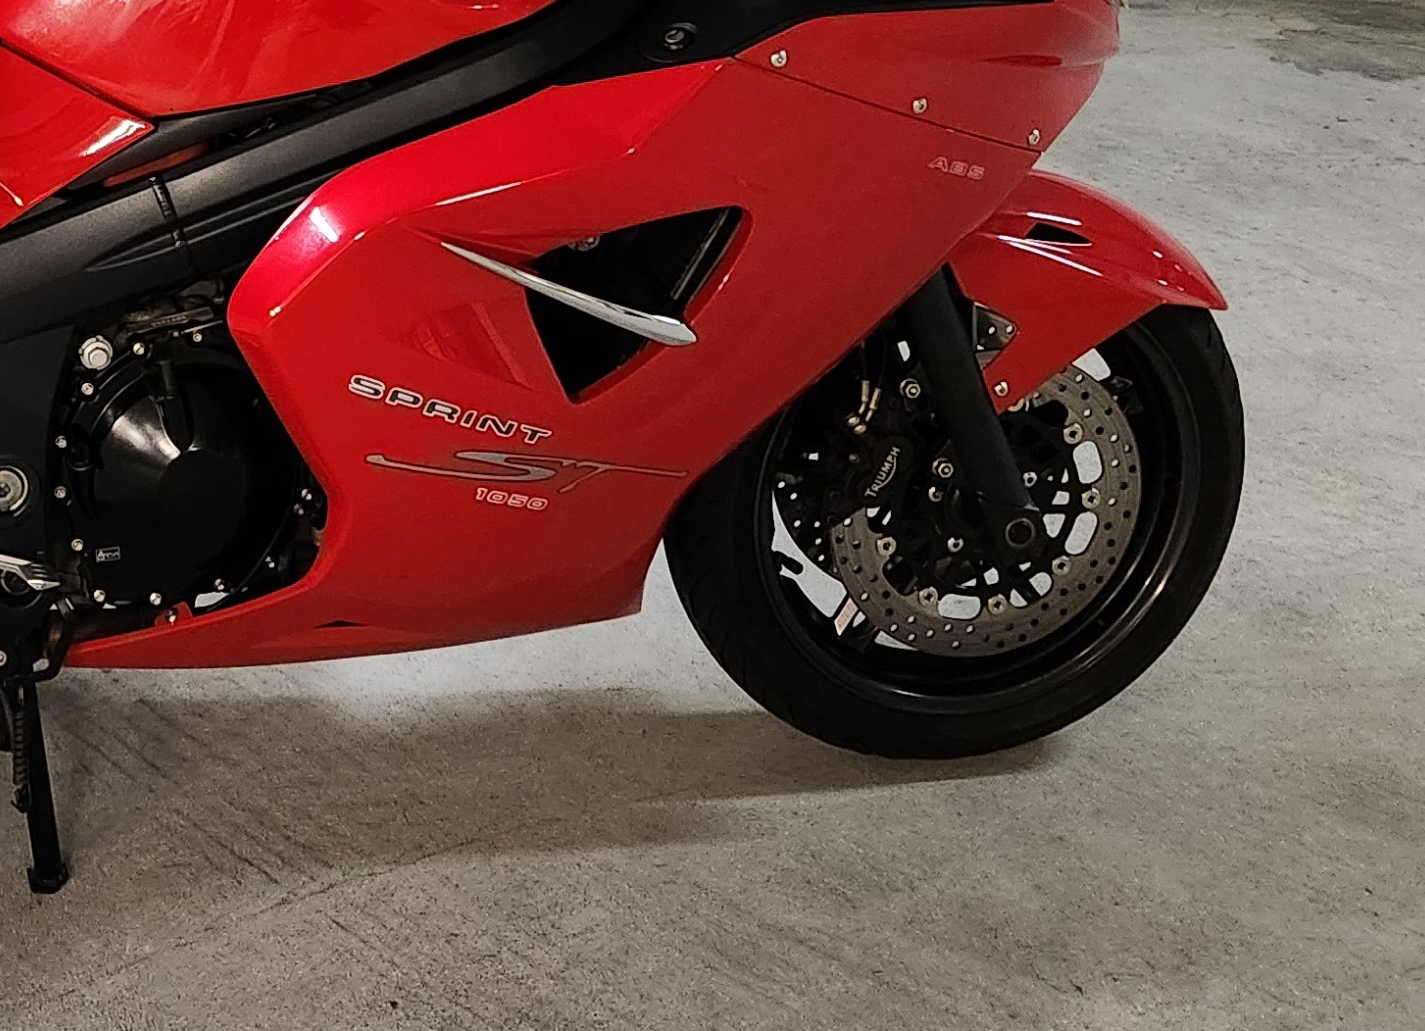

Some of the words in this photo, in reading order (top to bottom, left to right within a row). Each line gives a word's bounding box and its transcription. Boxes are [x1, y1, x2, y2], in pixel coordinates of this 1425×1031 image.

[928, 156, 985, 180] ABS
[349, 374, 552, 444] SPRINT
[365, 451, 688, 494] ST
[864, 447, 901, 497] TRIUMPH
[475, 487, 549, 511] 1050
